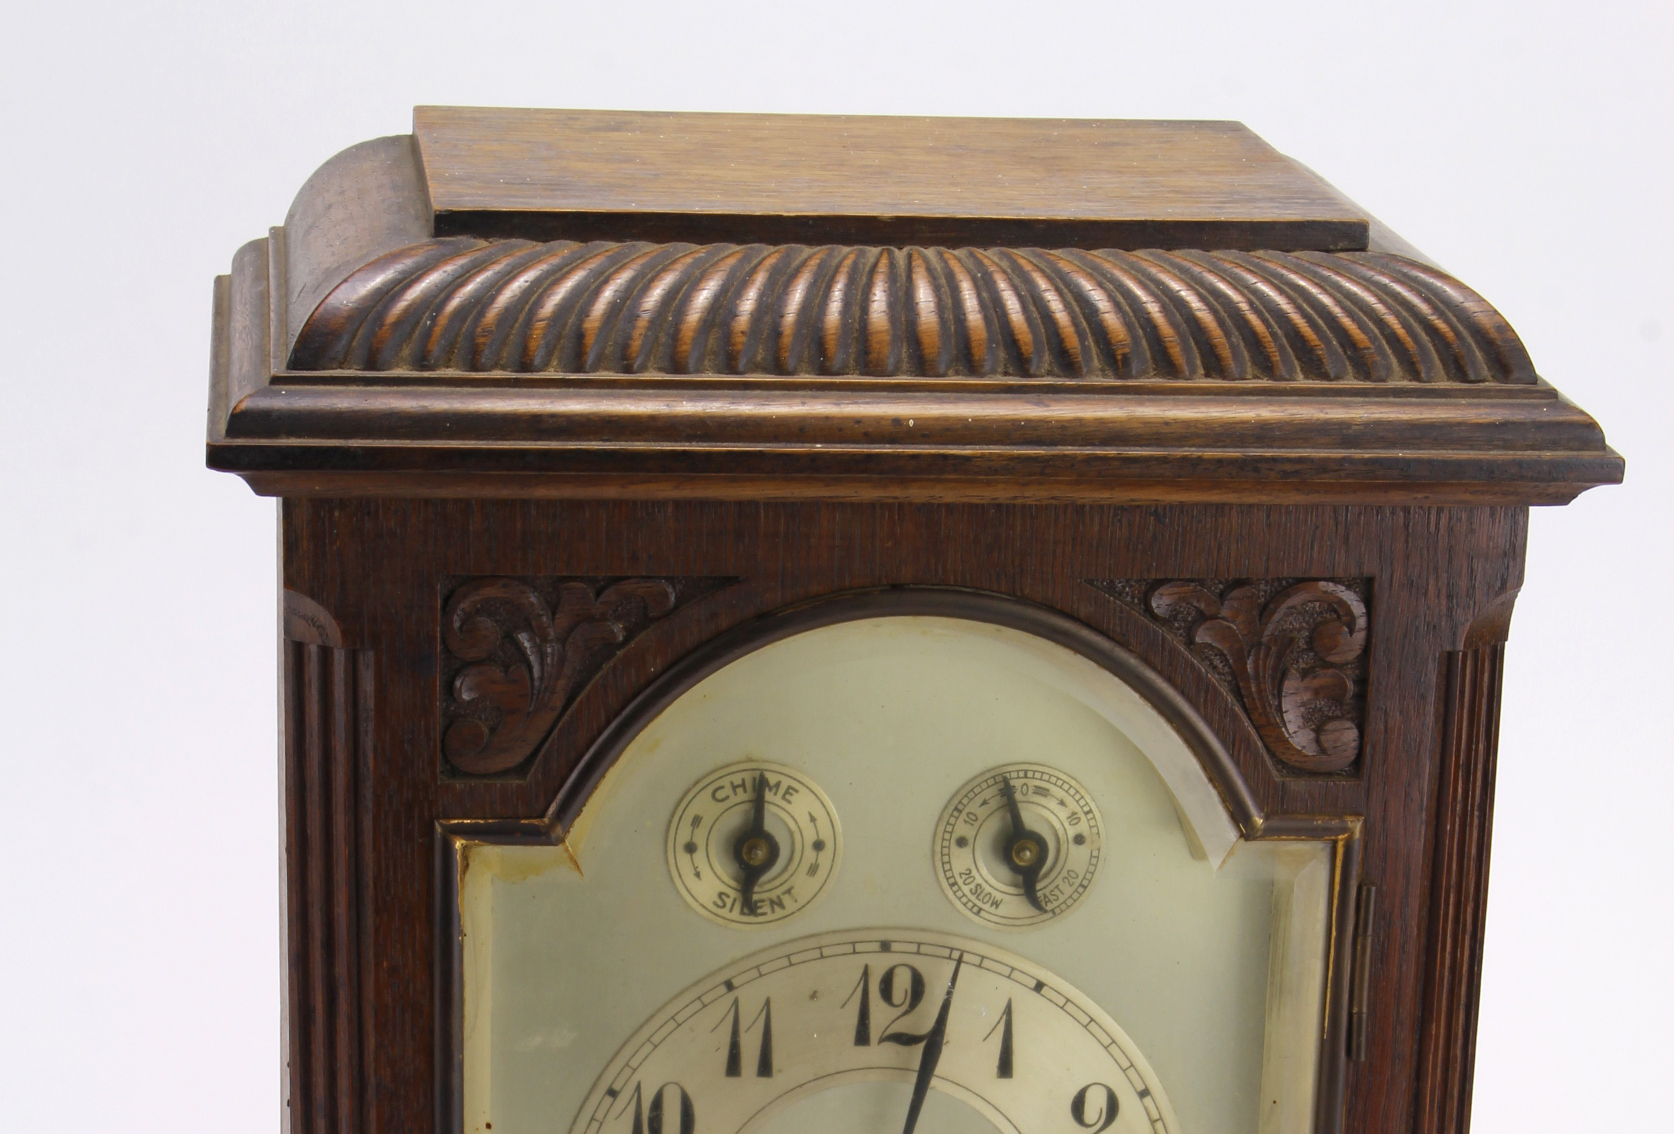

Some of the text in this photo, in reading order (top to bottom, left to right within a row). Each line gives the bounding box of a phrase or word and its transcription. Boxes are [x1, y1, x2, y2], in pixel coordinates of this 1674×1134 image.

[710, 775, 800, 805] CHIME
[963, 811, 979, 827] 10
[1066, 811, 1082, 827] 10
[959, 868, 1004, 910] 20 SLOW
[1062, 869, 1079, 888] 20
[840, 963, 926, 1047] 12
[710, 996, 774, 1078] 11
[982, 997, 1014, 1079] 1
